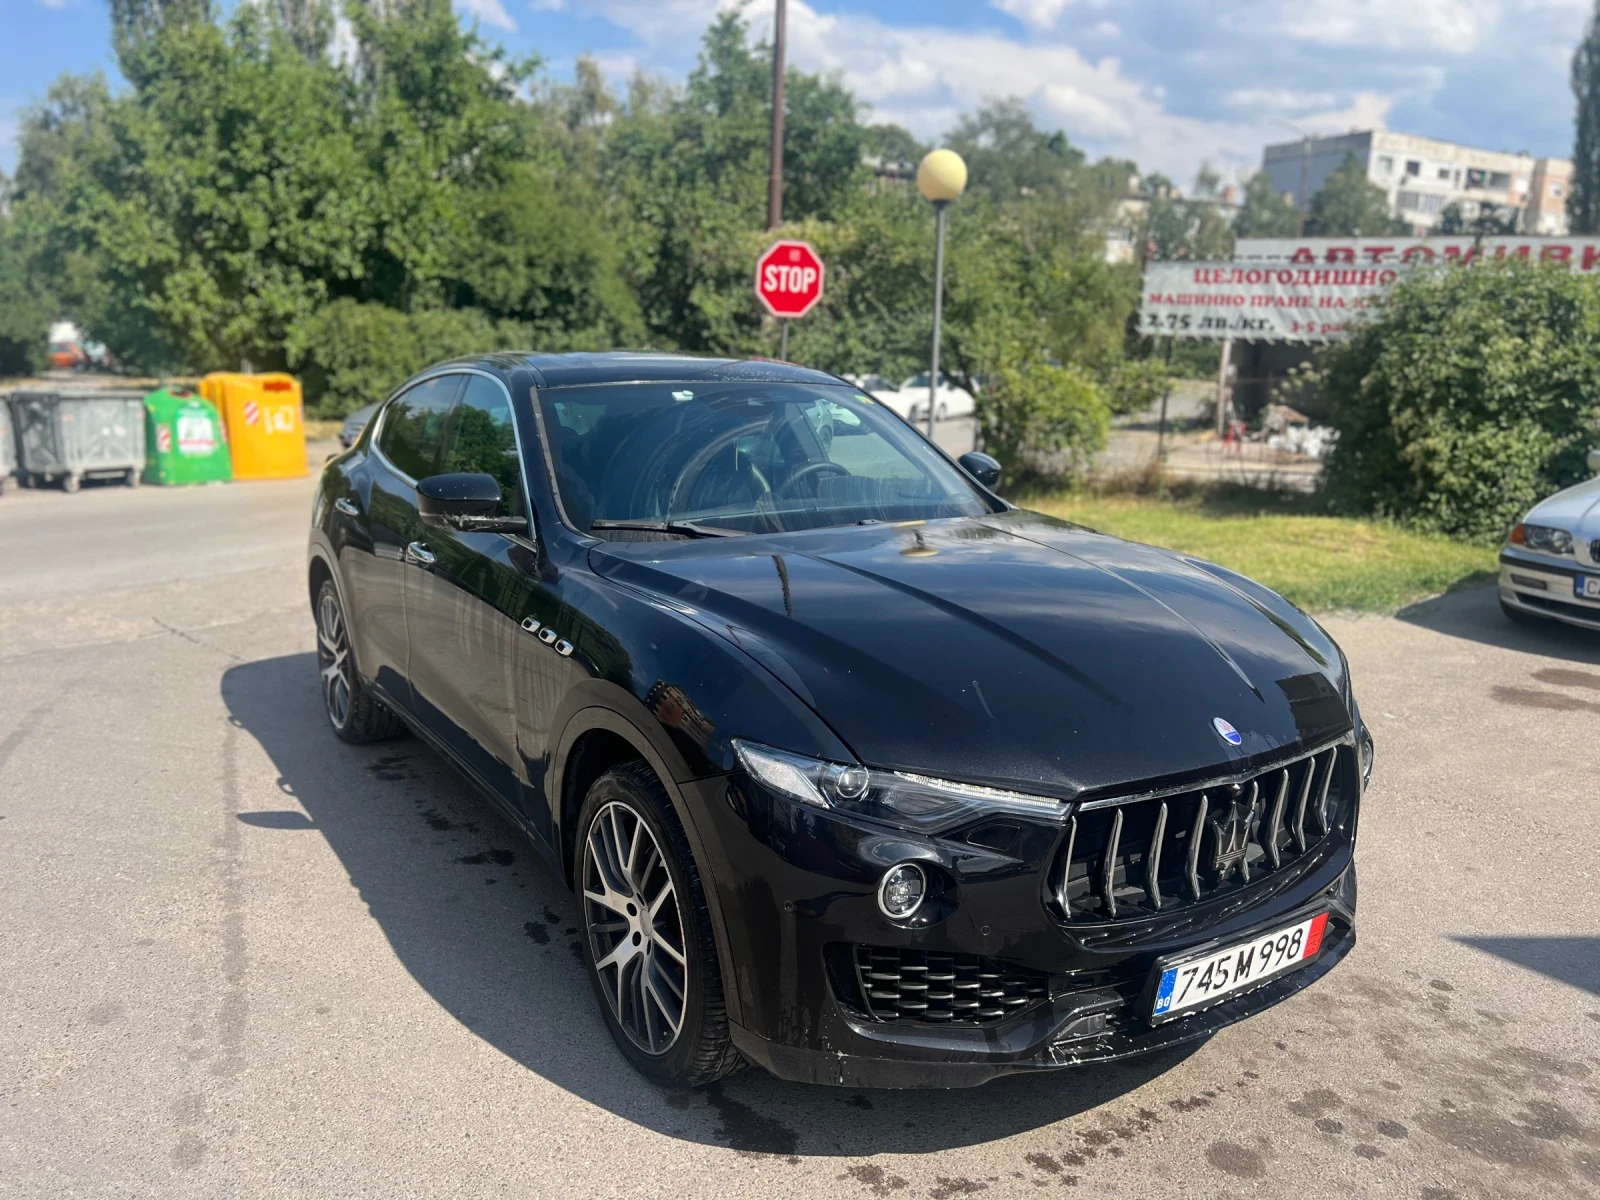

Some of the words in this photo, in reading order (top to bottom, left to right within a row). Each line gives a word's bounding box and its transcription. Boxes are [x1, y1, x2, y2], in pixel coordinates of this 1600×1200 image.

[763, 264, 817, 294] STOP
[1193, 267, 1397, 288] ЦЕЛОГОДИШНО
[1149, 292, 1246, 307] МАШИННО
[1250, 294, 1313, 309] ПРАНЕ
[1319, 295, 1346, 309] НА
[1176, 954, 1233, 1004] 745
[1232, 945, 1256, 984] M
[1258, 927, 1304, 974] 998
[1156, 995, 1171, 1010] BG
